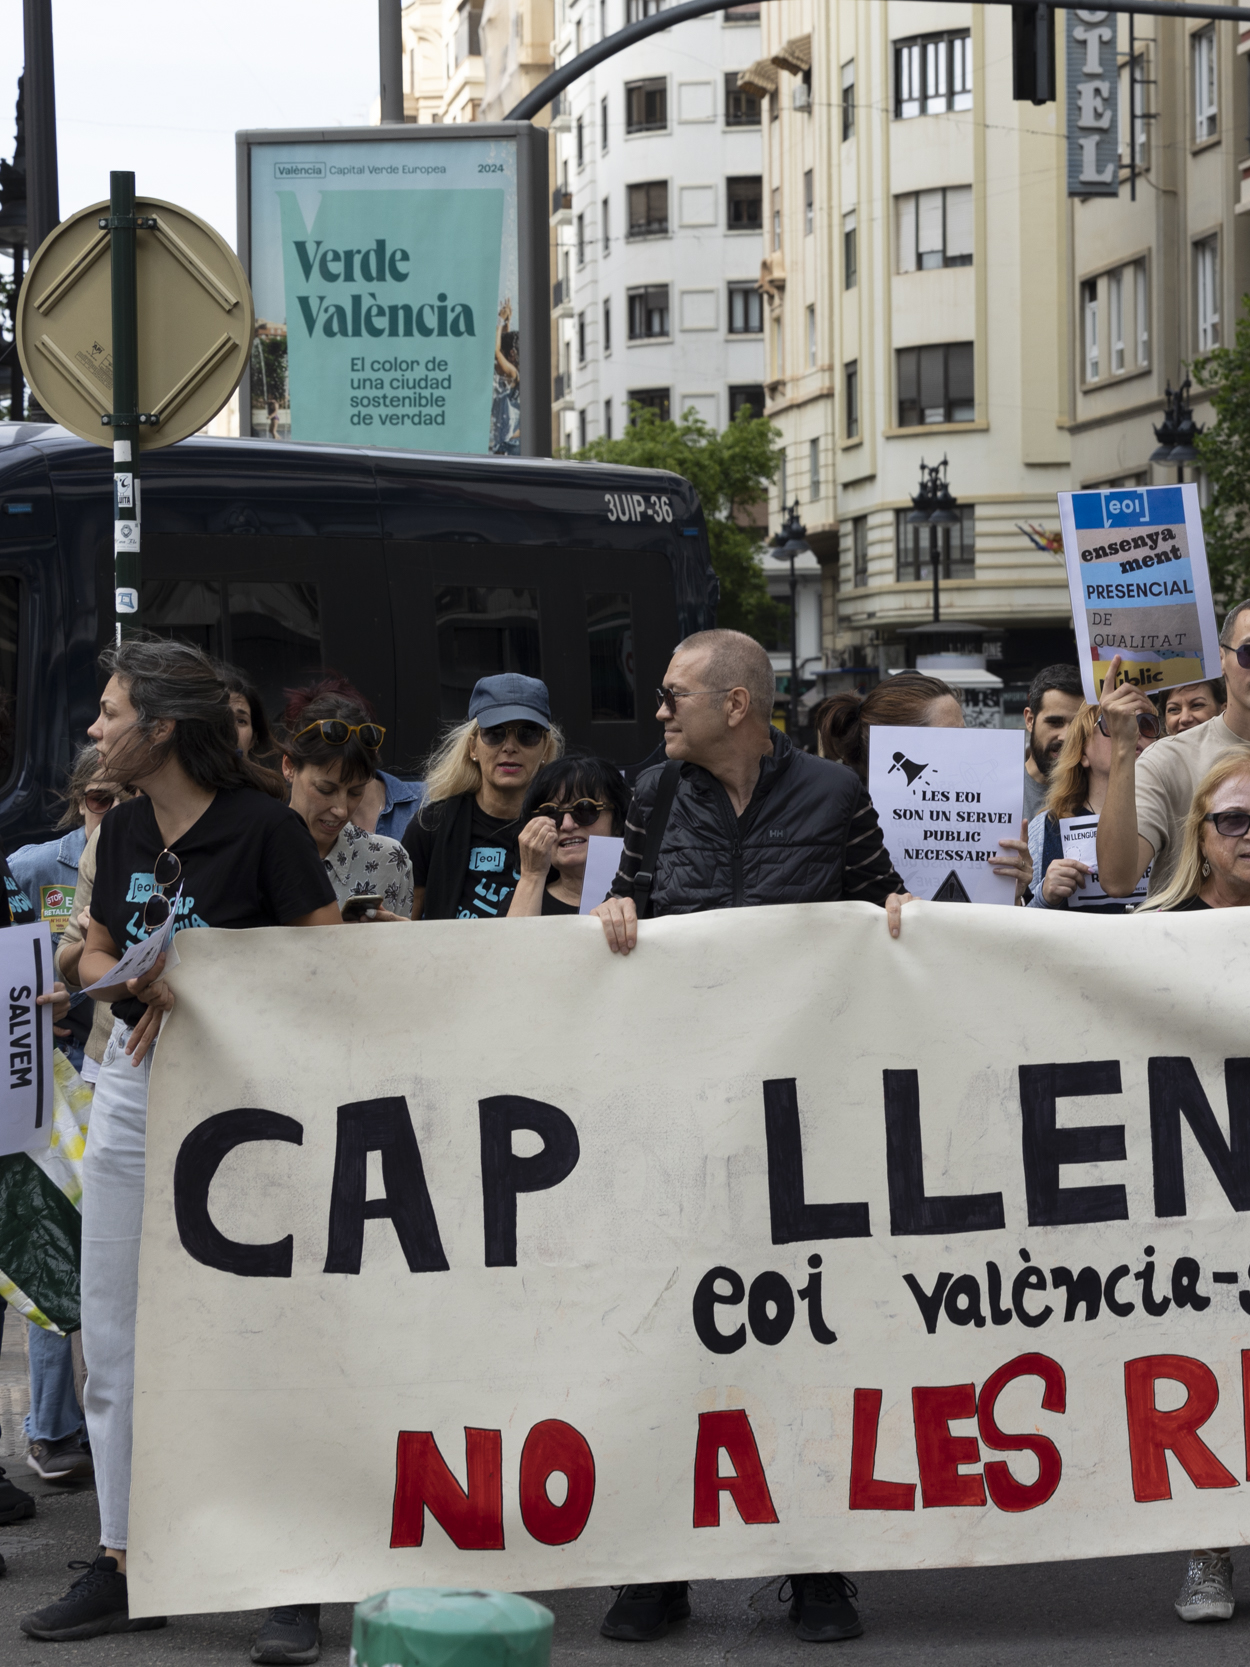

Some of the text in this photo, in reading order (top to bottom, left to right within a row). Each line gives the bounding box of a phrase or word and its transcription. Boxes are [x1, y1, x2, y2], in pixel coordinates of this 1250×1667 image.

[278, 163, 504, 177] València Capital Verde Europea 2024
[292, 238, 411, 284] Verde
[296, 292, 476, 339] València
[350, 356, 448, 372] El color de
[350, 374, 452, 390] una ciudad
[350, 392, 446, 408] sostenible
[350, 410, 446, 426] de verdad
[604, 493, 673, 523] 3UIP-36
[1081, 528, 1176, 563] ensenya
[1119, 544, 1182, 574] ment
[1086, 579, 1194, 600] PRESENCIAL
[1092, 612, 1113, 626] DE
[1093, 633, 1187, 648] QUALITAT
[921, 790, 982, 804] LES EOI
[892, 808, 1013, 824] SON UN SERVEI
[923, 829, 982, 843] PUBLIC
[1063, 830, 1097, 842] NI LLENGÜE
[46, 893, 64, 905] STOP
[9, 985, 33, 1090] SALVEM
[173, 1095, 580, 1278] CAP
[692, 1253, 838, 1355] eoi
[389, 1418, 597, 1551] NO
[693, 1409, 779, 1528] A
[849, 1352, 1068, 1513] LES
